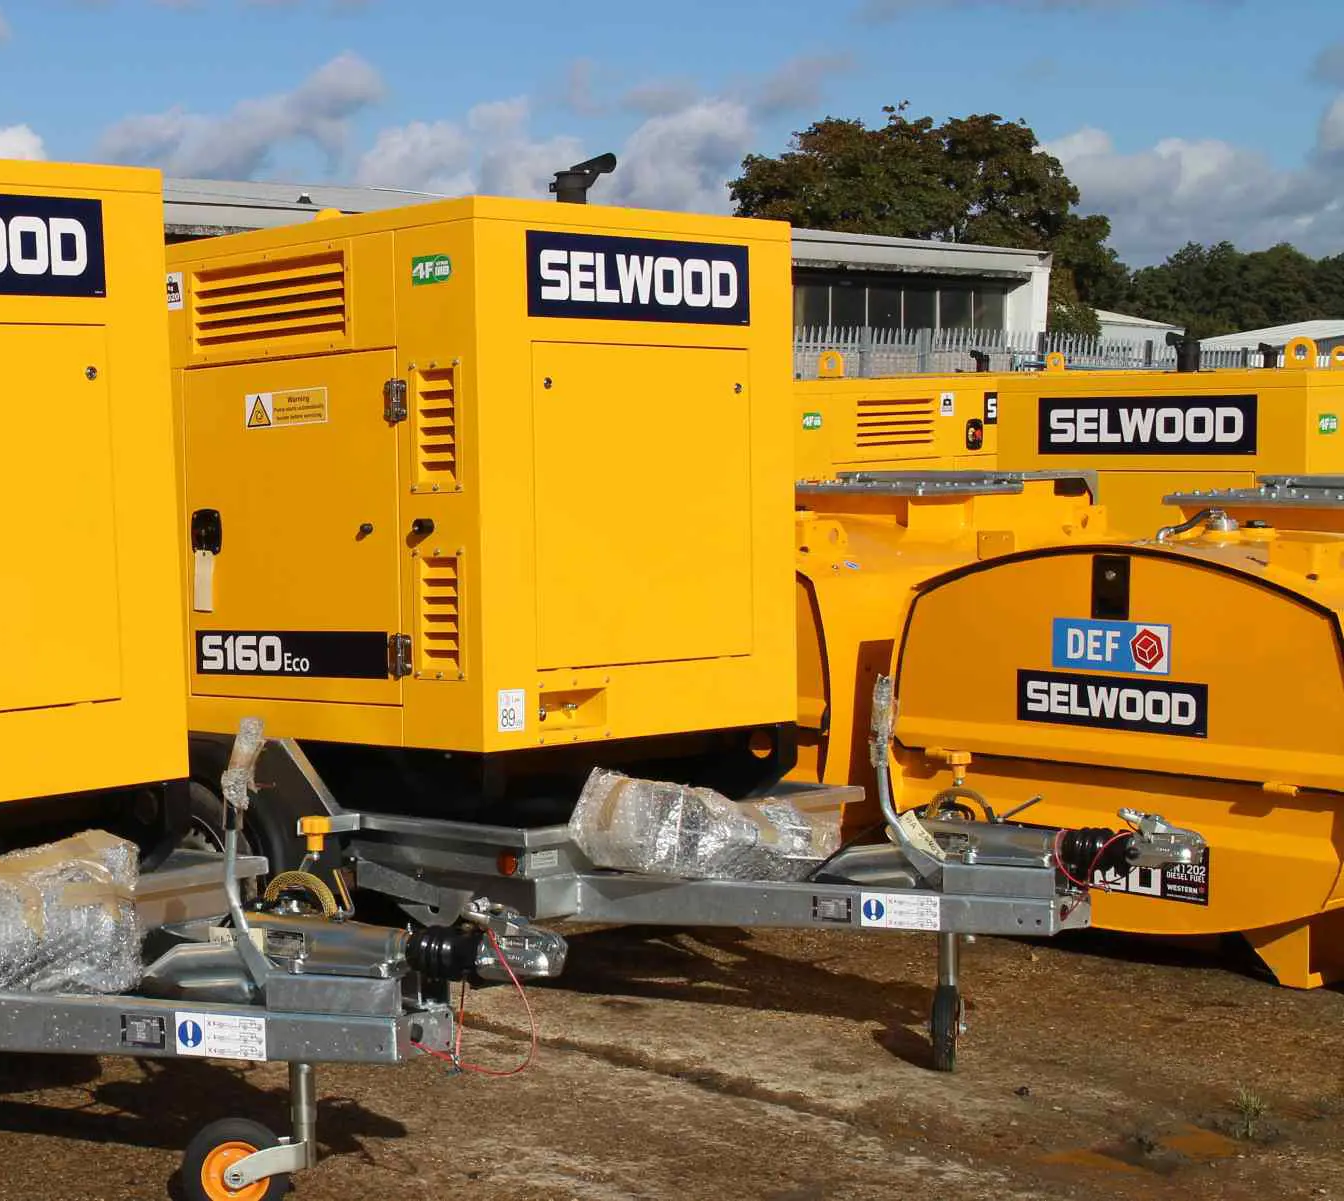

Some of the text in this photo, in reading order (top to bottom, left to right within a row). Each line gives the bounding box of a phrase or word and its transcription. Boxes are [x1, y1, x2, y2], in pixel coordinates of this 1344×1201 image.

[540, 249, 738, 308] SELWOOD
[1050, 407, 1244, 443] SELWOOD
[202, 635, 310, 672] S160 Eco
[1067, 627, 1121, 662] DEF
[501, 708, 516, 728] 89
[1026, 680, 1197, 726] SELWOOD
[1167, 871, 1205, 883] DIESEL FUEL
[1168, 864, 1206, 877] N1202
